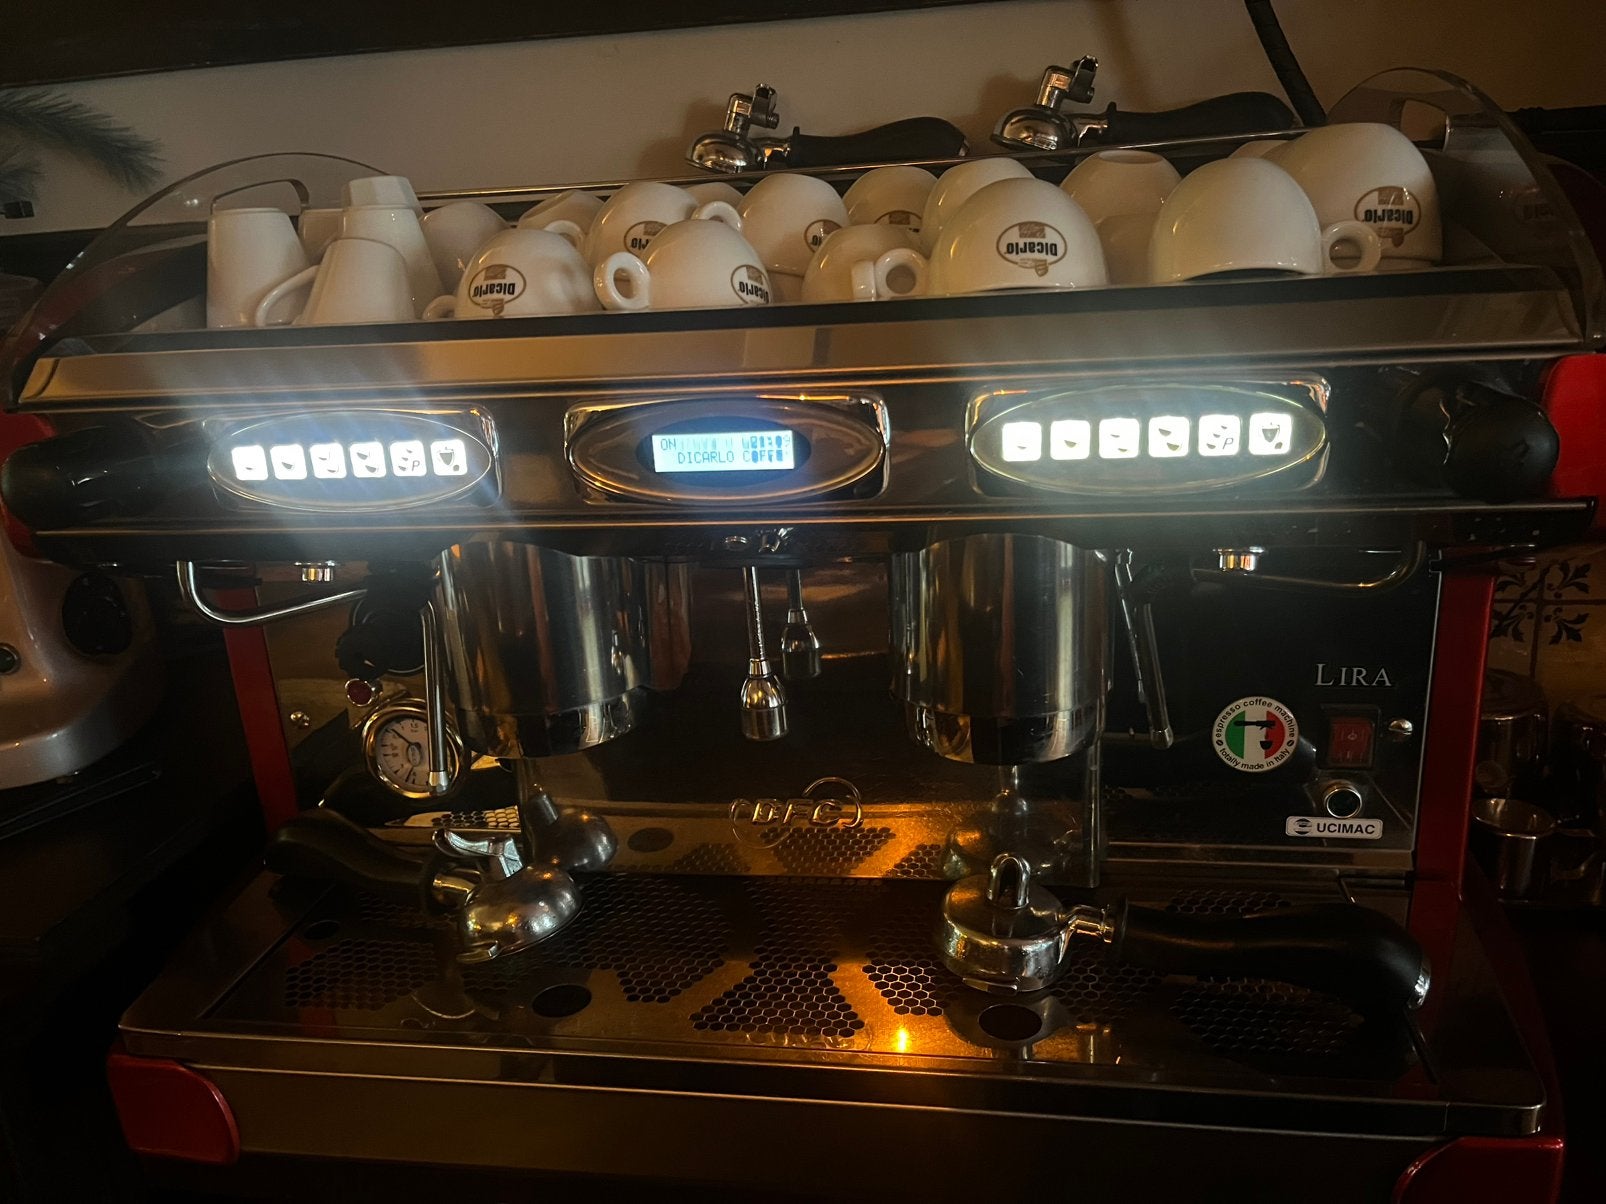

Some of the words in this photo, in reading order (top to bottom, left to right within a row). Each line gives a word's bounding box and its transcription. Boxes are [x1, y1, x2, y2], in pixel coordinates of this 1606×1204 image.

[660, 438, 677, 451] ON
[677, 451, 735, 464] DICARLO
[1215, 704, 1241, 738] espresso
[1243, 698, 1273, 708] coffee
[1274, 705, 1295, 738] machine
[1219, 748, 1241, 767] totally
[1274, 748, 1290, 763] Italy
[1316, 822, 1376, 835] UCIMAC
